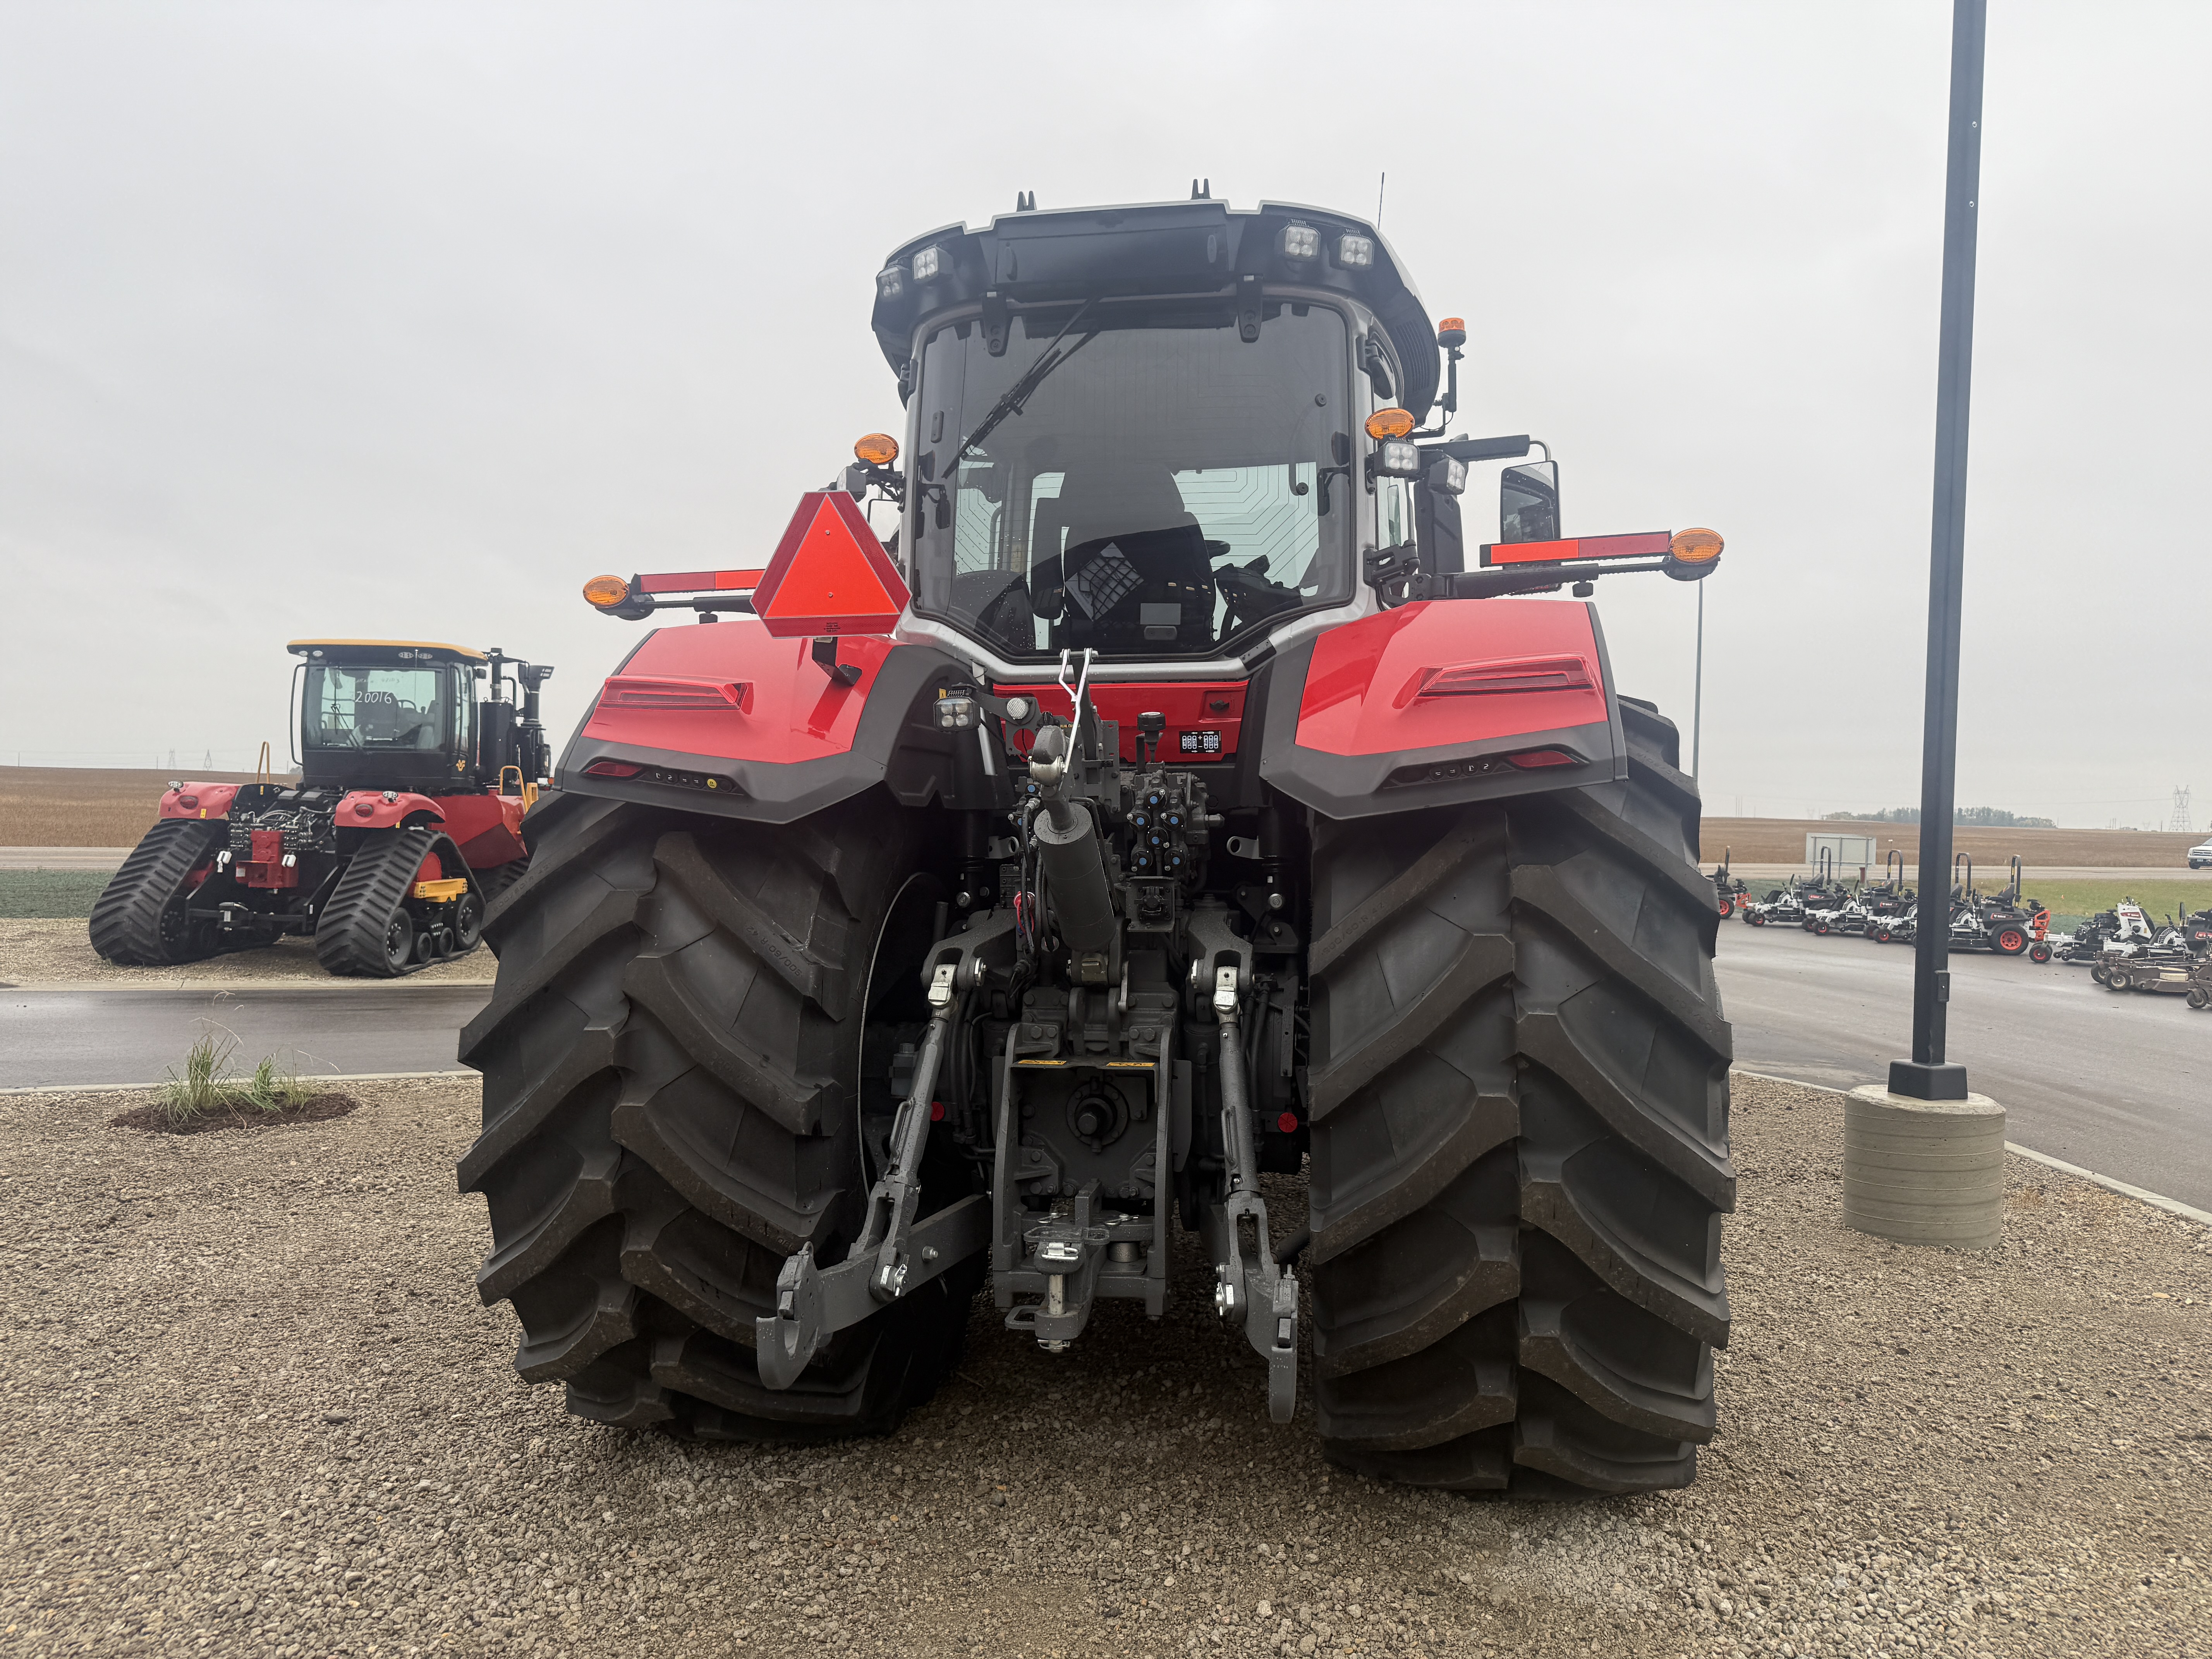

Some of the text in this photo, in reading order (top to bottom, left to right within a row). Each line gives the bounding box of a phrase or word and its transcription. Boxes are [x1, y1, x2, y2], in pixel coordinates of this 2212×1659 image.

[355, 691, 392, 704] 20016
[745, 924, 759, 938] 42
[768, 944, 802, 977] 900/60
